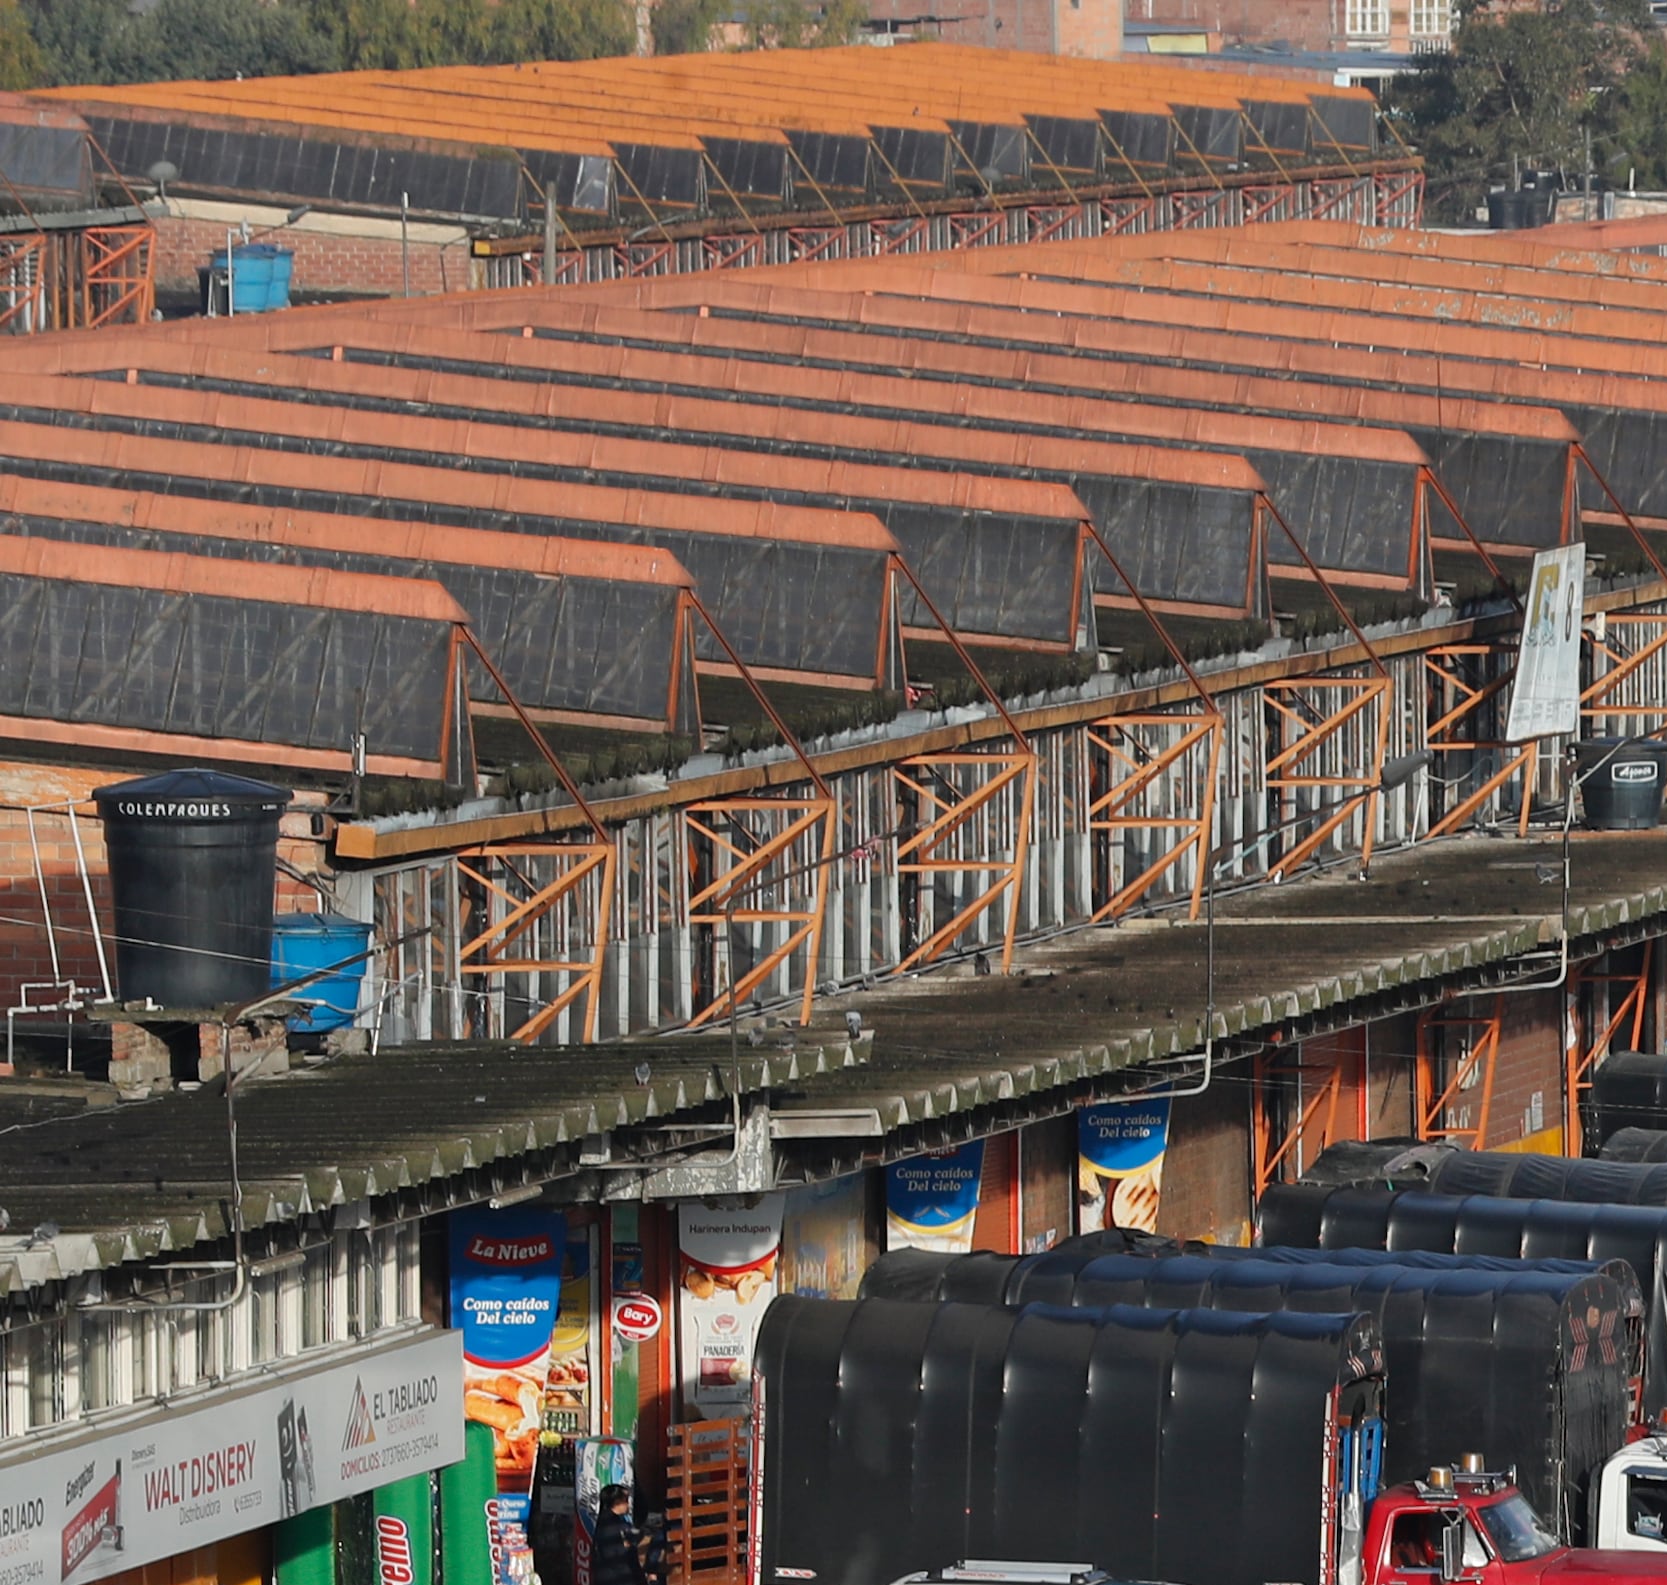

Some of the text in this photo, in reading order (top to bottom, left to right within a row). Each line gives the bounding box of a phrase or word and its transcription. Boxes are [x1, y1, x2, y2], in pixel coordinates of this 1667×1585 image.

[118, 802, 231, 816] COLEMPAQUES
[1088, 1114, 1161, 1126] Como caídos
[1099, 1127, 1150, 1138] Del cielo
[896, 1167, 974, 1179] Como caídos
[907, 1181, 961, 1191] Del cielo
[689, 1224, 771, 1234] Harinera Indupan
[472, 1239, 548, 1260] La Nieve
[463, 1297, 549, 1311] Como caídos
[476, 1311, 536, 1325] Del cielo
[623, 1307, 654, 1326] Bary
[373, 1375, 438, 1420] EL TABLIADO
[145, 1461, 188, 1512] WALT
[191, 1440, 256, 1499] DISNERY
[0, 1497, 44, 1537] BLIADO
